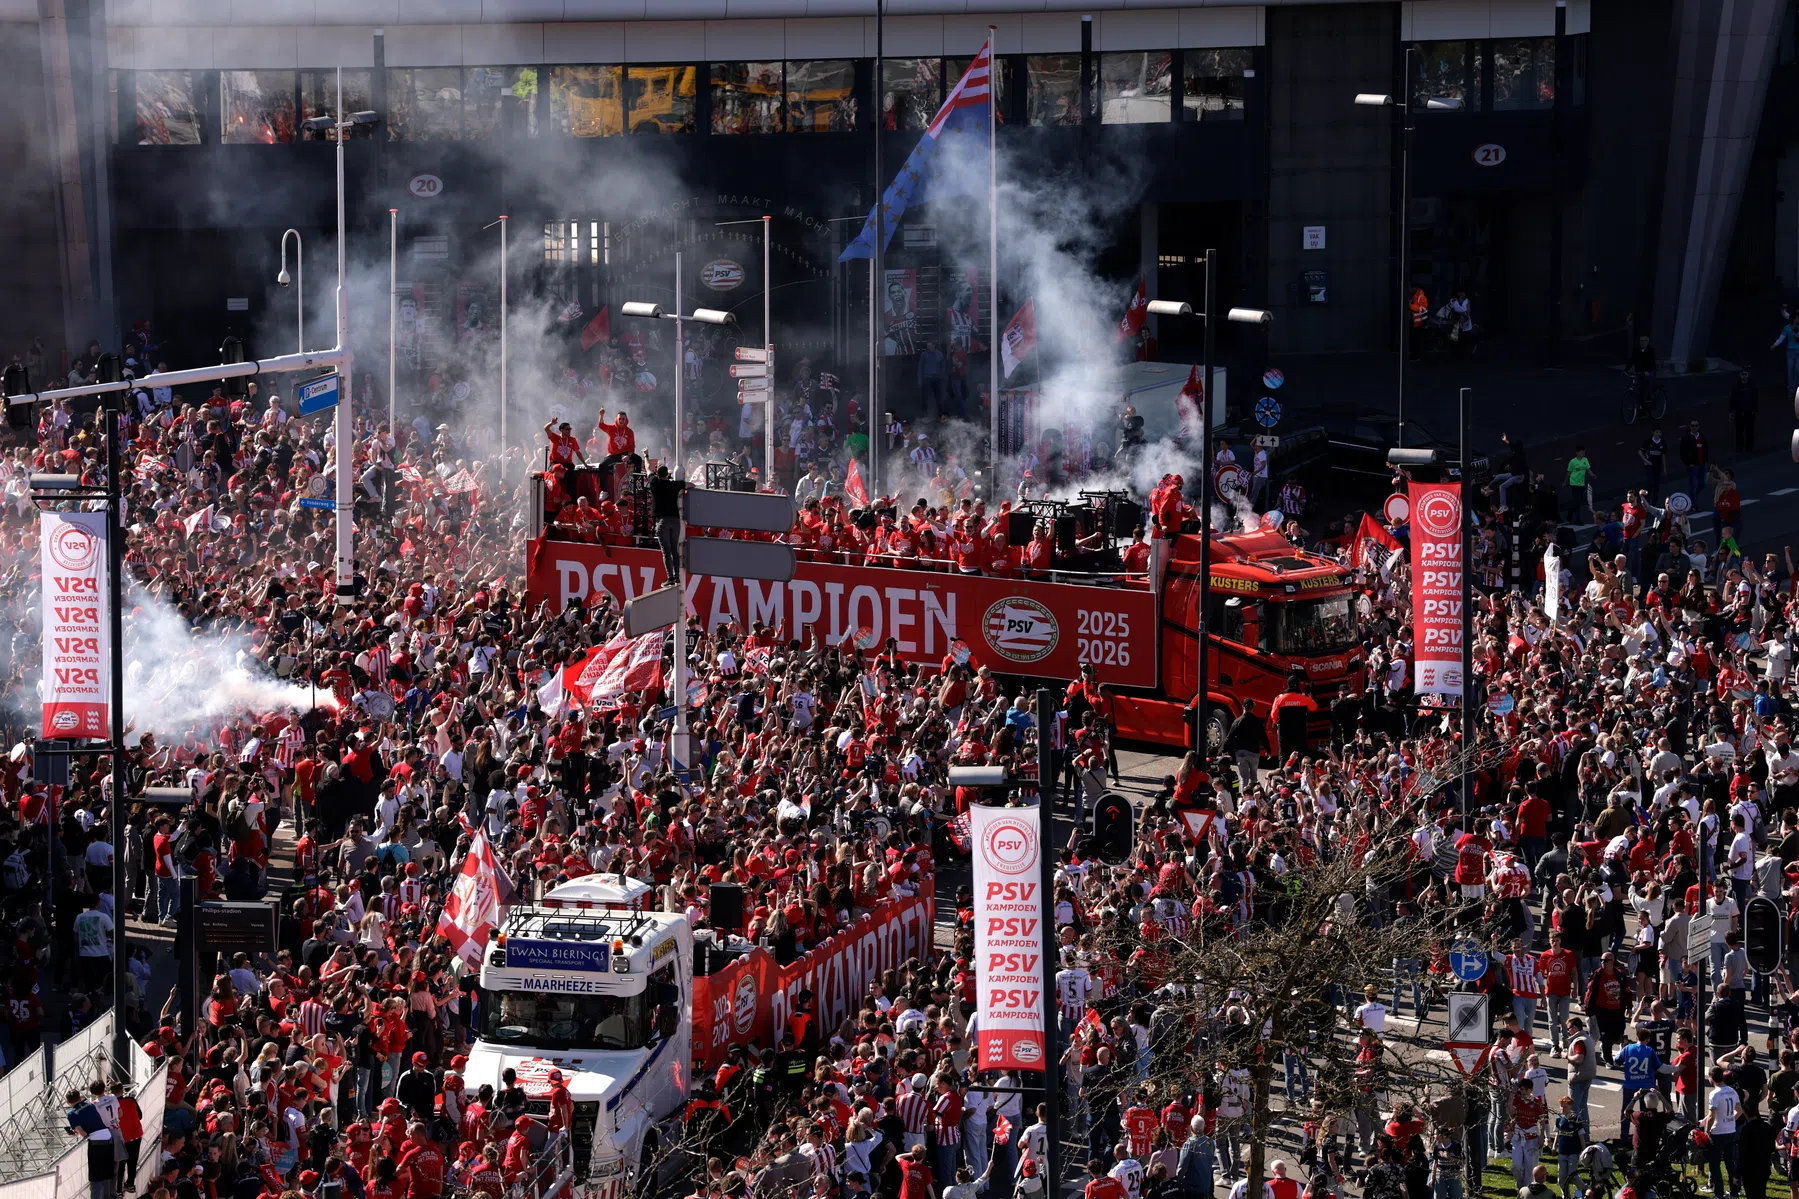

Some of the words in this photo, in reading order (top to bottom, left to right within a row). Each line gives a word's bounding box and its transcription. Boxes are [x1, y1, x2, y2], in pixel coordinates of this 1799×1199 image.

[1482, 149, 1499, 162] 21
[415, 179, 437, 193] 20
[614, 197, 700, 243] EENDRACHT
[718, 194, 772, 209] MAAKT
[784, 206, 832, 237] MACHT
[714, 270, 731, 278] PSV
[306, 500, 329, 508] Vonderweg
[1430, 510, 1450, 518] PSV
[1421, 543, 1462, 559] PSV
[1210, 576, 1259, 592] KUSTERS
[1300, 575, 1340, 590] KUSTERS
[1422, 571, 1462, 587] PSV
[1423, 600, 1462, 616] PSV
[1007, 619, 1034, 634] PSV
[1077, 609, 1130, 638] 2025
[1424, 628, 1463, 644] PSV
[1077, 638, 1131, 667] 2026
[1312, 660, 1343, 672] SCANIA
[854, 746, 860, 757] 7
[1287, 806, 1293, 817] 4
[997, 840, 1023, 850] PSV
[986, 881, 1037, 901] PSV
[986, 903, 1037, 912] KAMPIOEN
[987, 917, 1038, 937] PSV
[987, 939, 1038, 948] KAMPIOEN
[510, 946, 548, 958] TWAN
[552, 948, 605, 962] BIERINGS
[554, 959, 585, 967] TRANSPORT
[817, 899, 932, 1040] KAMPIOEN
[988, 953, 1039, 973] PSV
[523, 978, 594, 993] MAARHEEZE
[988, 975, 1039, 984] KAMPIOEN
[1068, 981, 1077, 999] 5
[740, 995, 749, 1011] PSV
[989, 989, 1040, 1009] PSV
[9, 999, 30, 1020] 26
[989, 1011, 1041, 1020] KAMPIOEN
[1655, 1032, 1665, 1050] 5
[1628, 1056, 1649, 1075] 24
[106, 1104, 114, 1119] 7
[1725, 1097, 1734, 1117] 11
[1137, 1120, 1145, 1133] 9
[1127, 1170, 1140, 1192] 23
